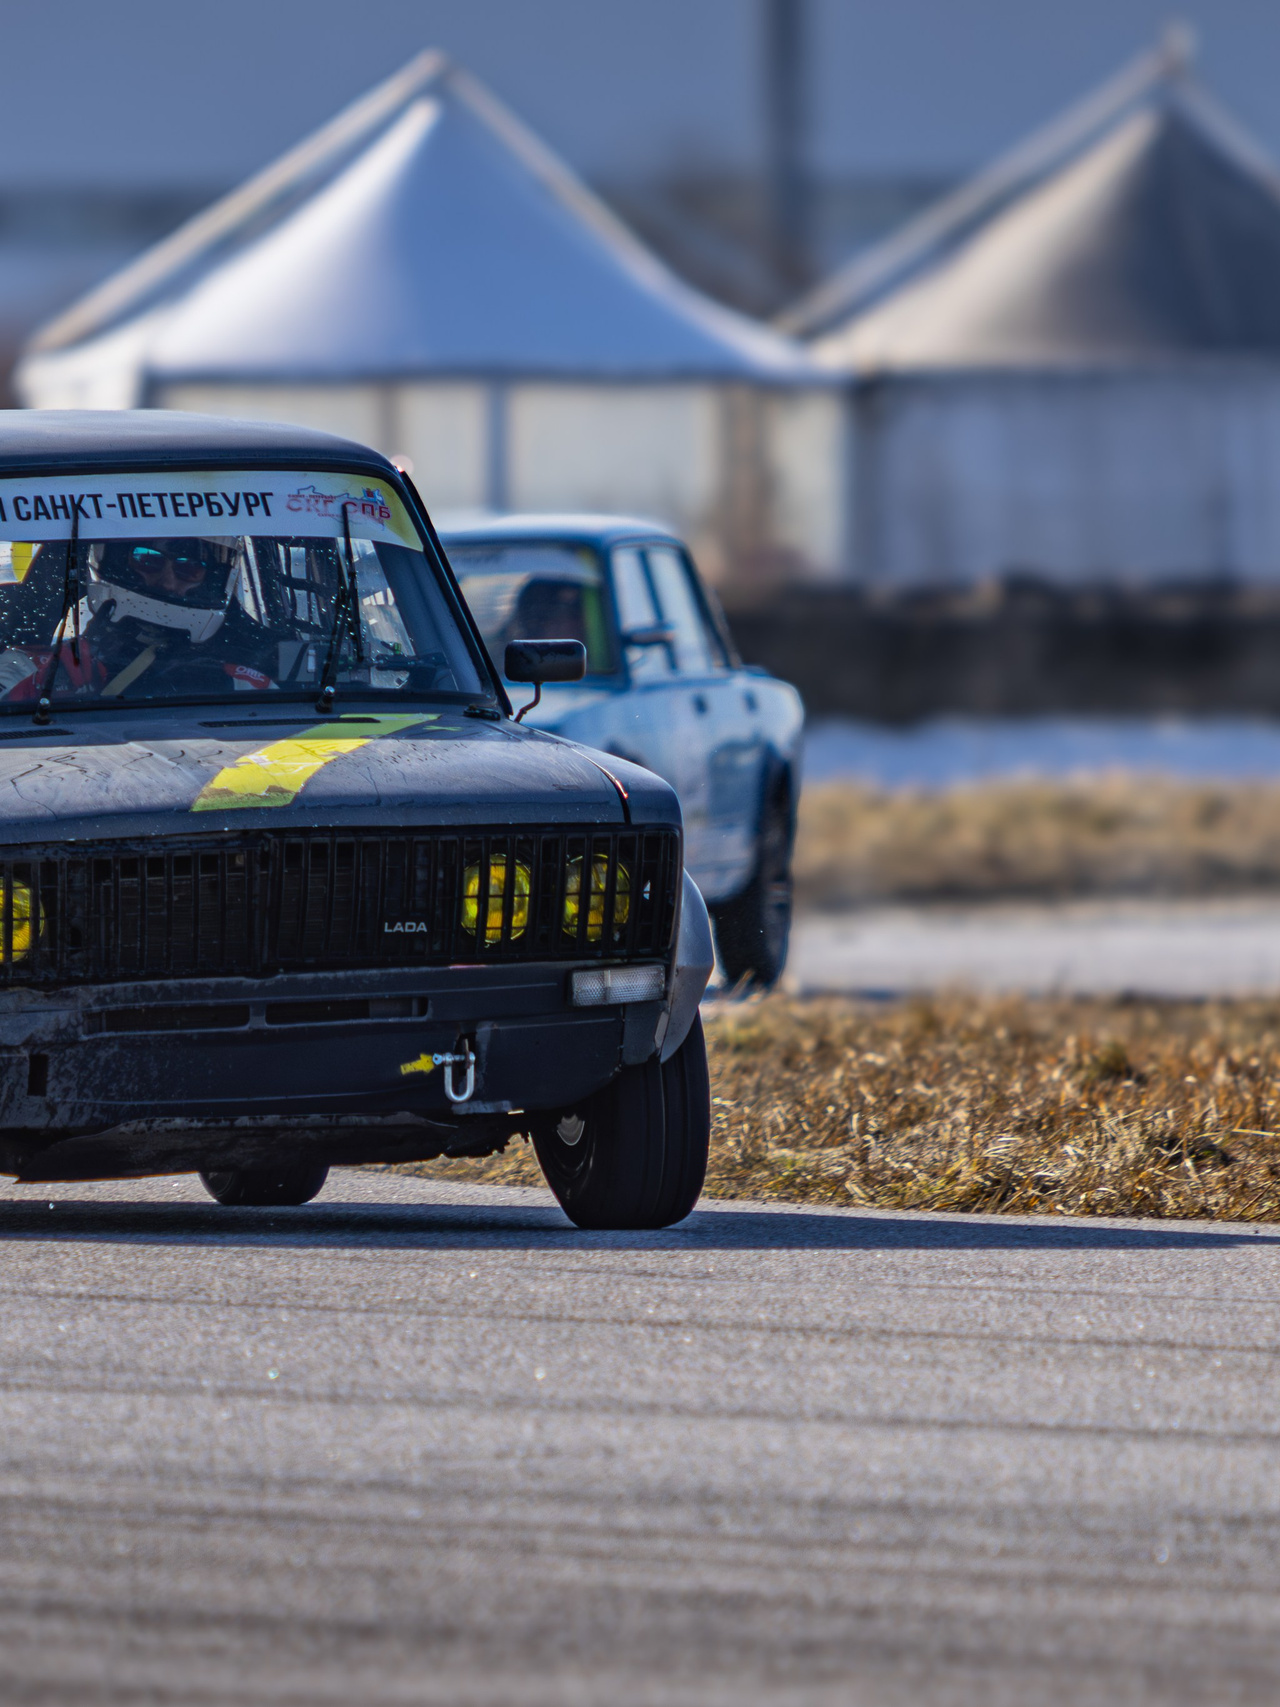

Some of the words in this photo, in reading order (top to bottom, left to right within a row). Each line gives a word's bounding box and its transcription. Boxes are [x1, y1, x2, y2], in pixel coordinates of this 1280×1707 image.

[12, 491, 274, 521] САНКТ-ПЕТЕРБУРГ
[343, 500, 391, 520] СПБ
[384, 921, 428, 933] LADA
